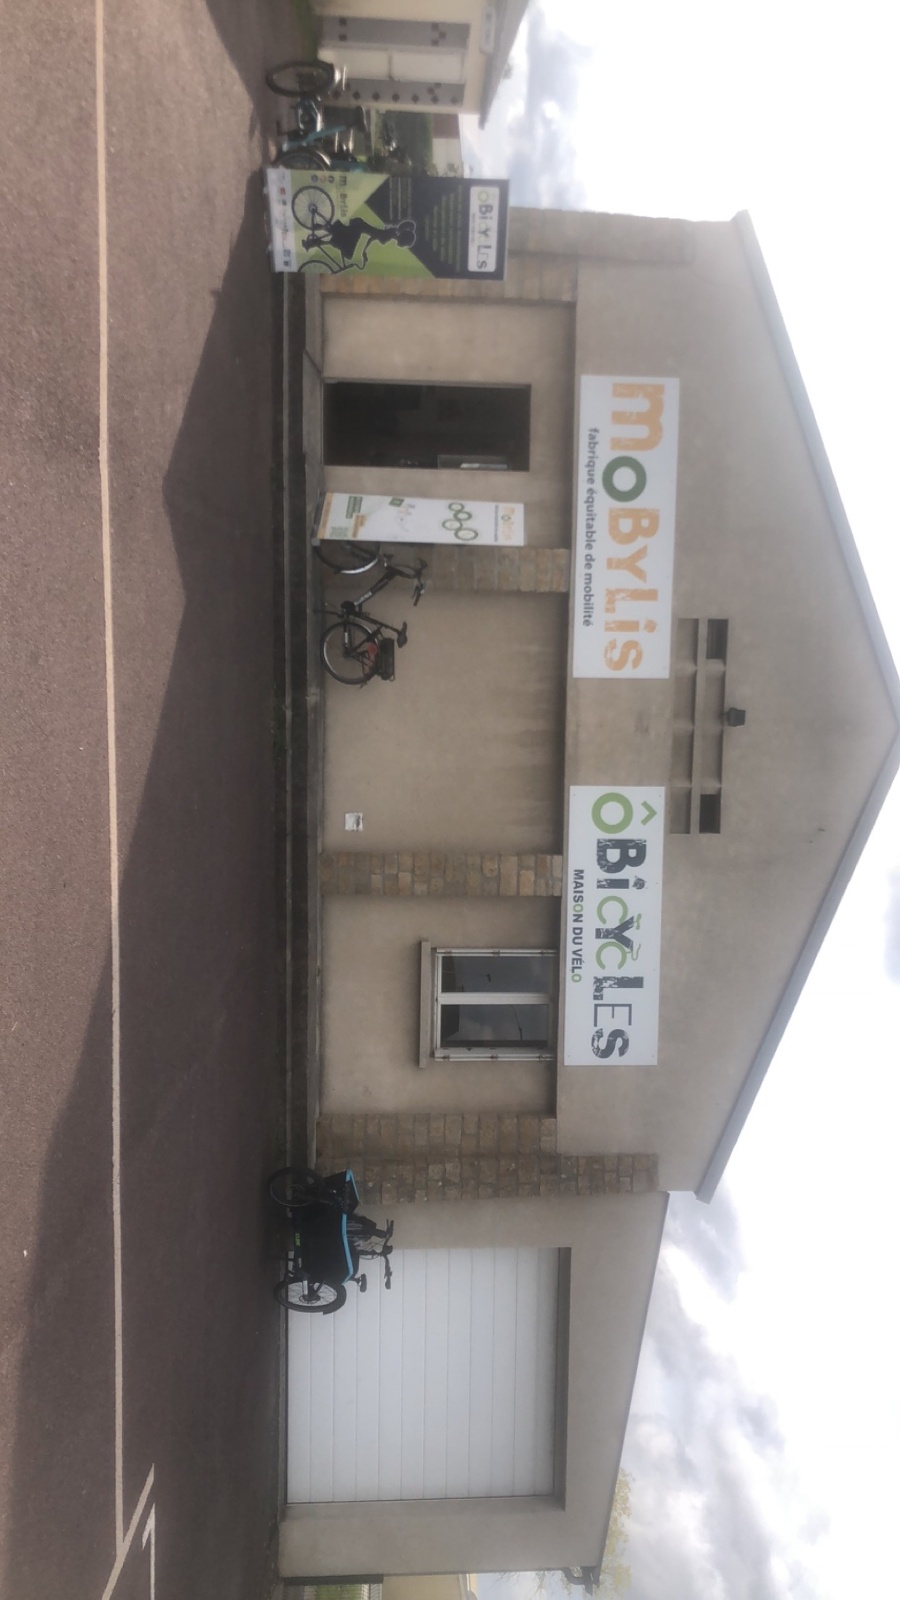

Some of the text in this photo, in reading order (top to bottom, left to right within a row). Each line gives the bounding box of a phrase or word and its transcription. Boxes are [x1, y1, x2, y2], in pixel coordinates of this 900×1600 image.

[582, 428, 600, 626] fabrique équitable de mobilité
[571, 869, 585, 983] MAISON DU VÉLO
